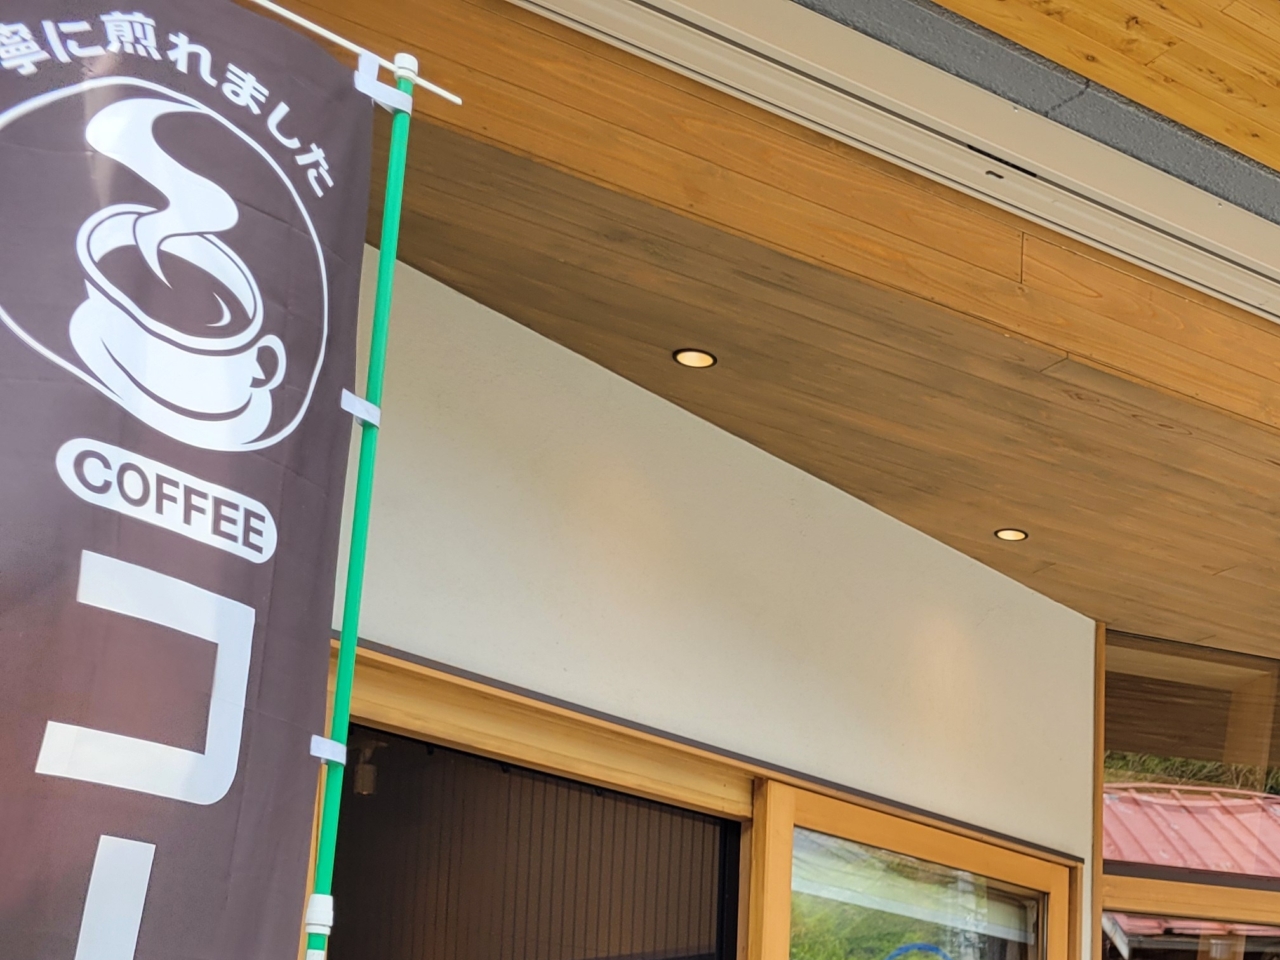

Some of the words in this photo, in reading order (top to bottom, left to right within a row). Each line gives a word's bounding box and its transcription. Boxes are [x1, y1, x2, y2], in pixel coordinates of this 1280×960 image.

[0, 11, 335, 199] 寧に煎れました
[72, 449, 267, 556] COFFEE
